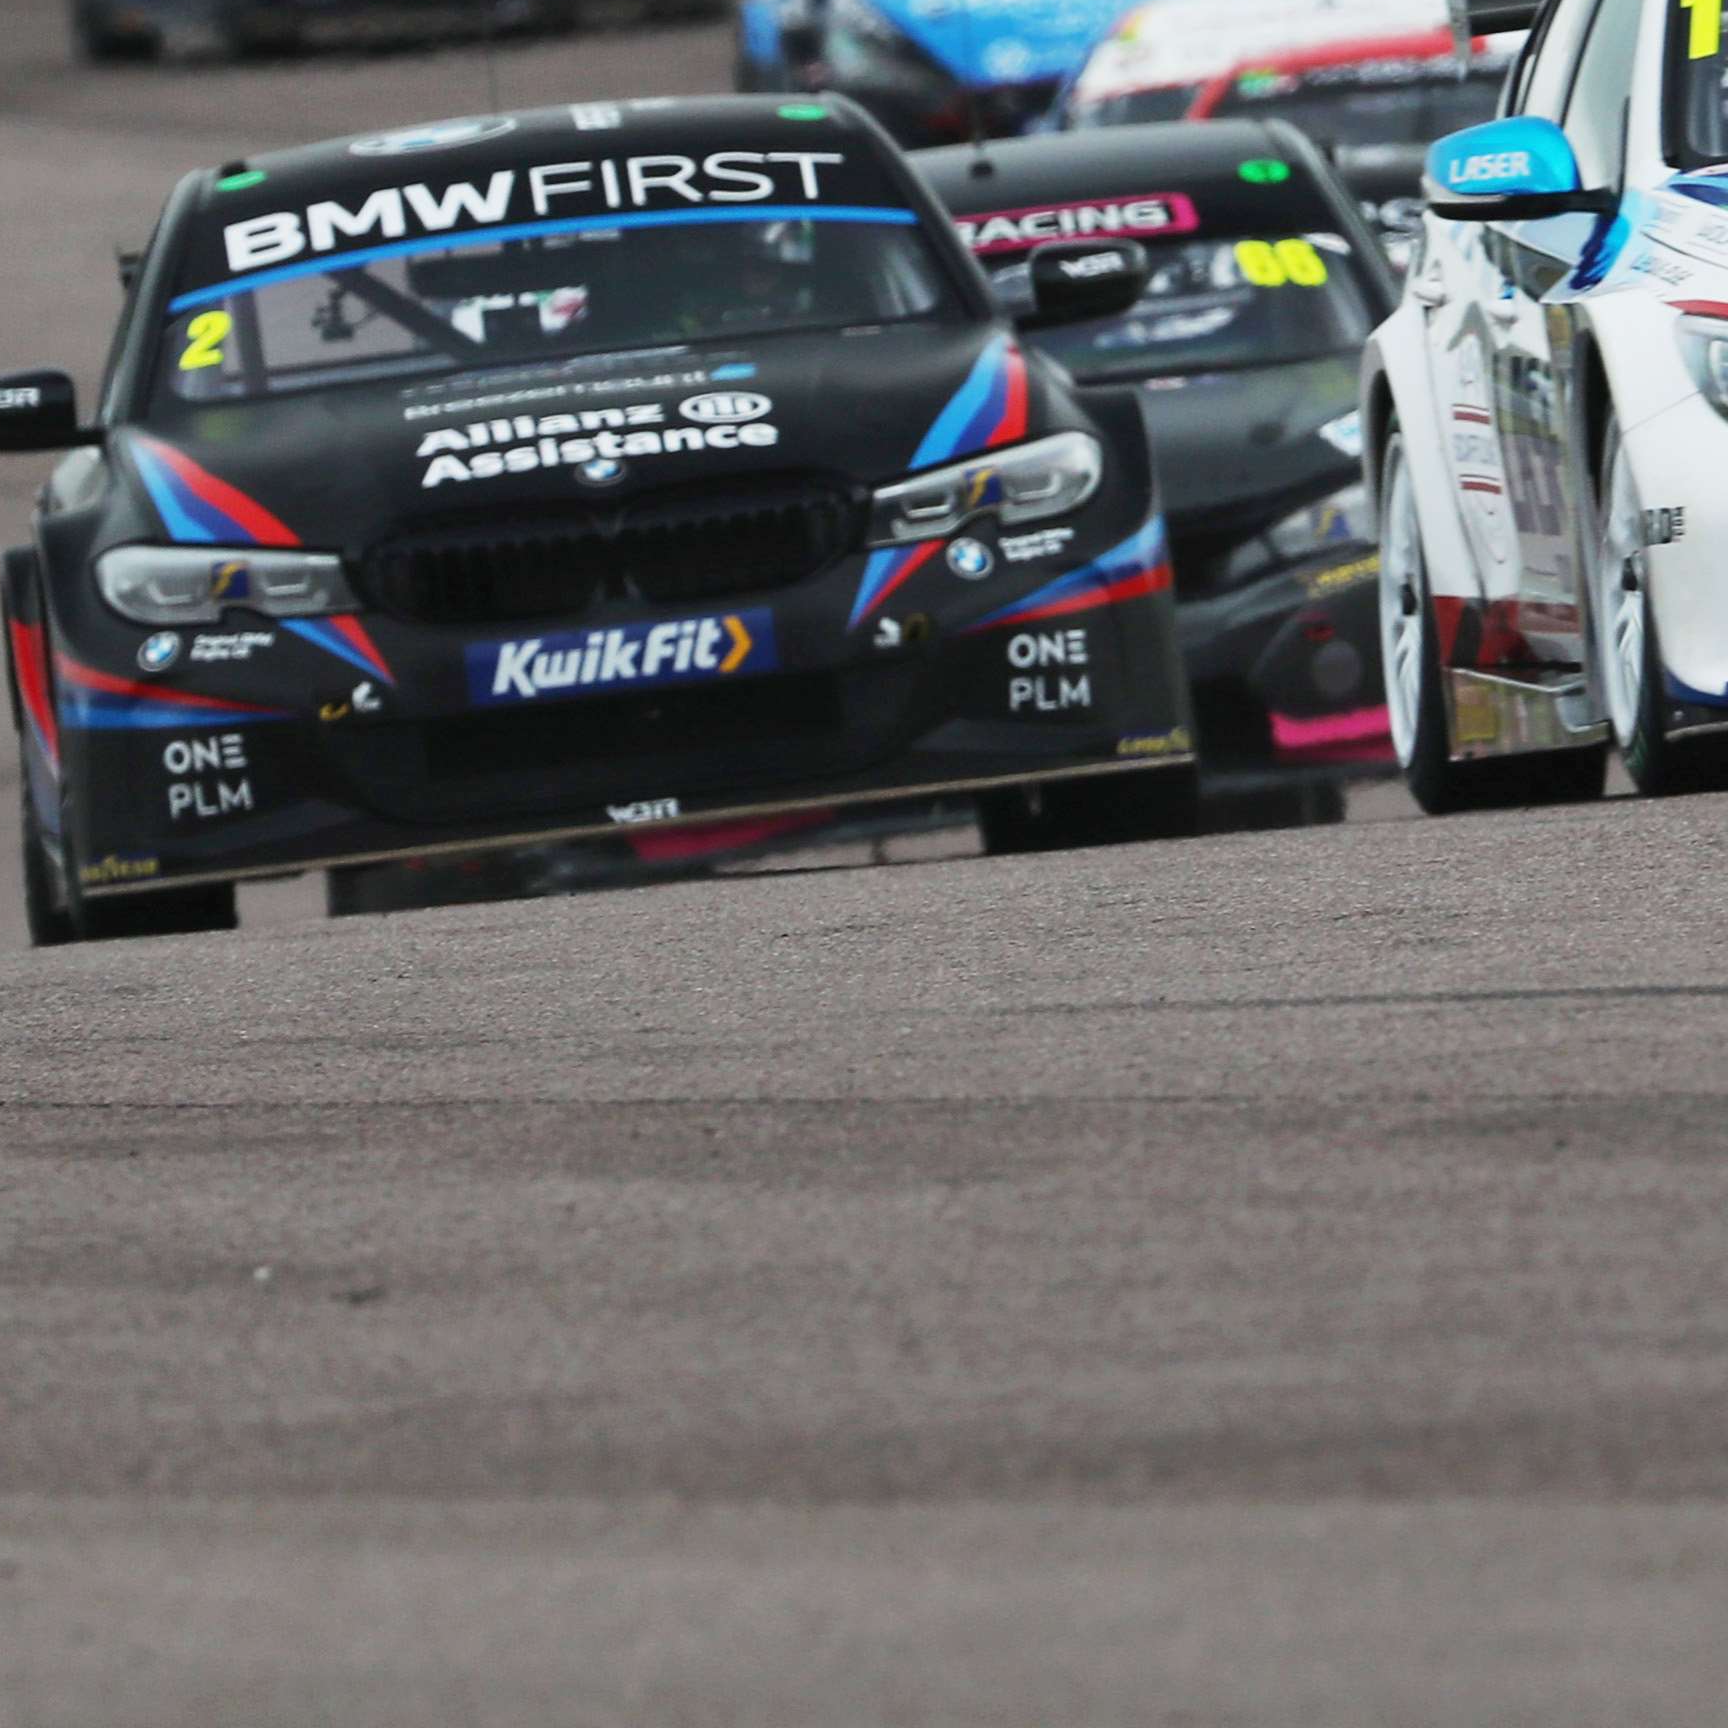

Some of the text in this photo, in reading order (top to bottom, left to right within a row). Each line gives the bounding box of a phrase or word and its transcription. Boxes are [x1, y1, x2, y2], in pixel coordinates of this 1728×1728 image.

[1449, 152, 1530, 184] LASER
[223, 151, 844, 271] BMW FIRST
[179, 310, 232, 370] 2
[416, 402, 665, 457] Allianz
[421, 423, 779, 489] Assistance
[1008, 628, 1089, 669] ONE
[1008, 675, 1091, 712] PLM
[163, 733, 248, 774] ONE
[168, 779, 254, 818] PLM
